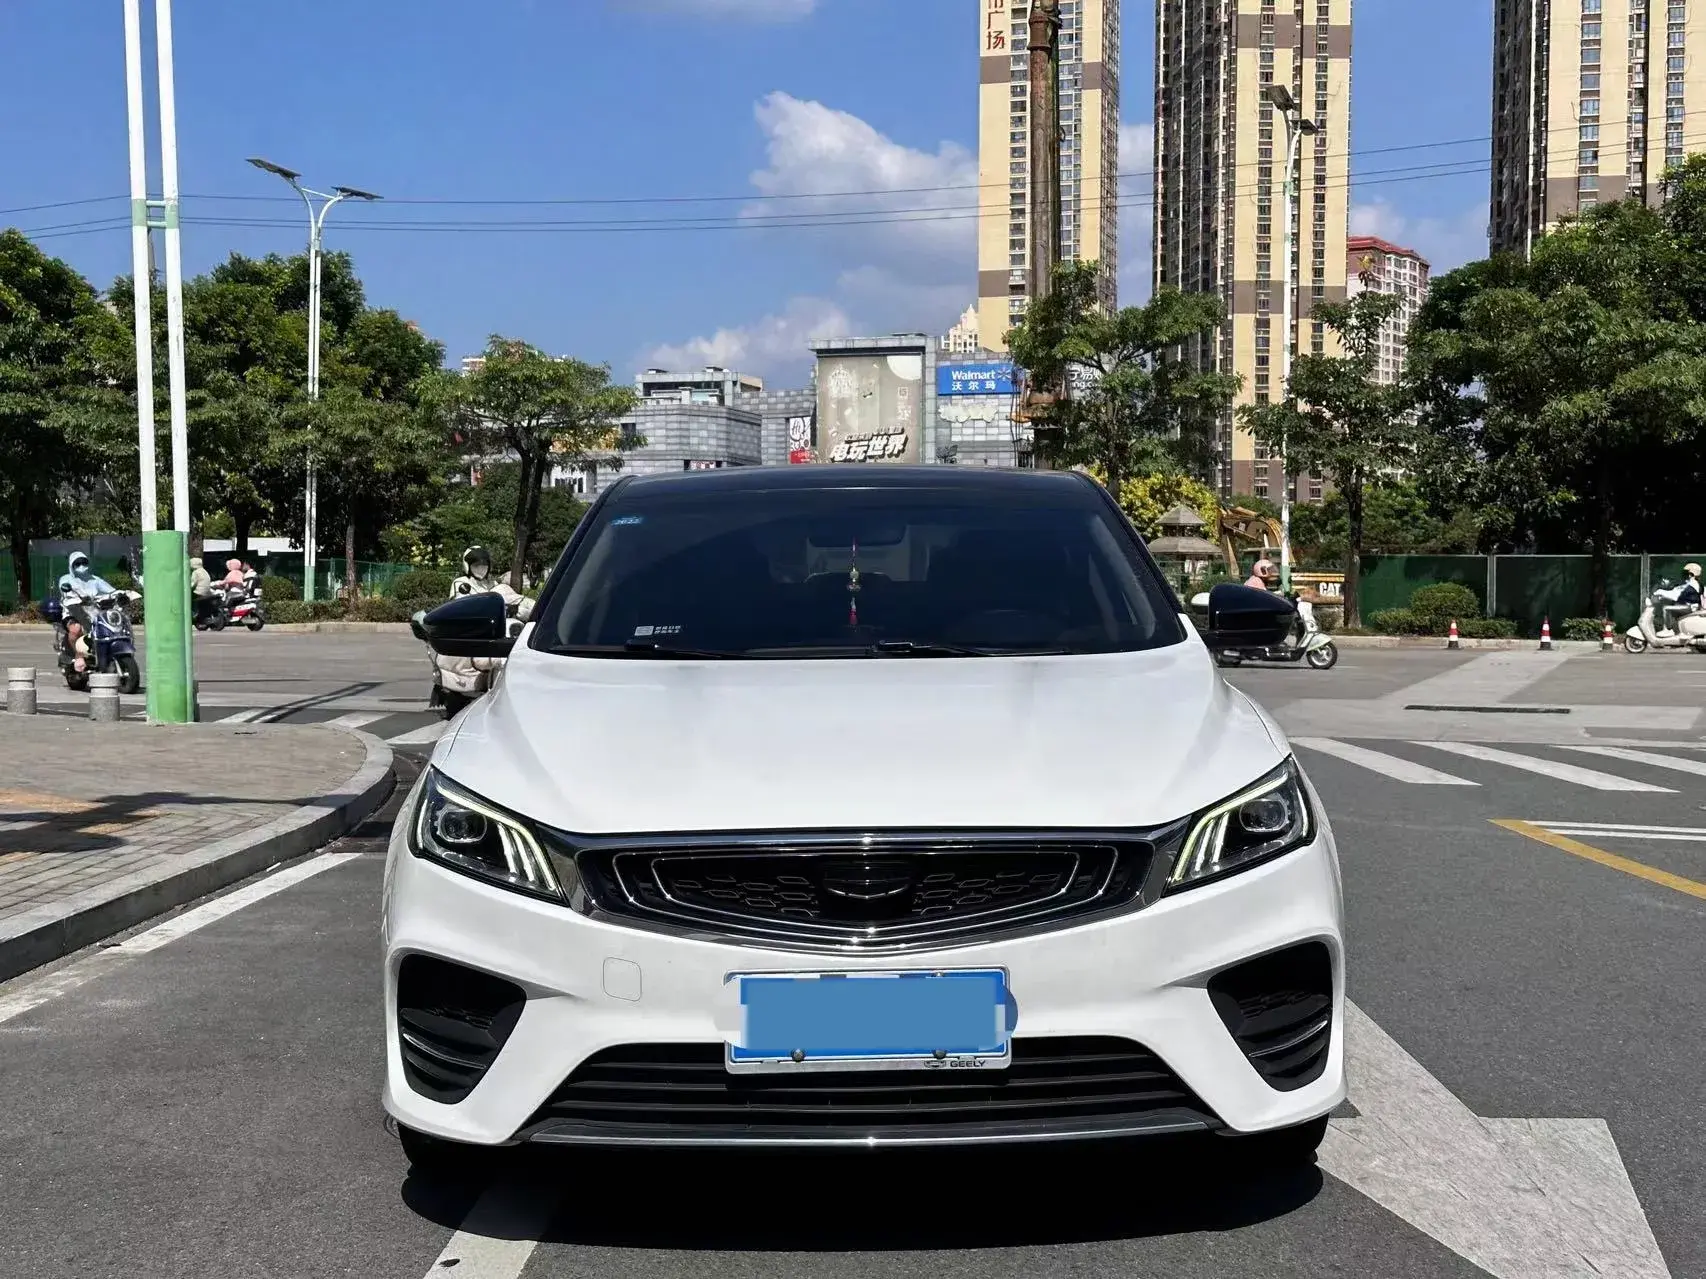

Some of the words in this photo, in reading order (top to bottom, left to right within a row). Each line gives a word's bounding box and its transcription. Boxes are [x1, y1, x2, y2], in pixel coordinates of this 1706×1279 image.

[951, 370, 996, 381] Walmart
[951, 380, 996, 391] 沃尔玛
[830, 434, 908, 462] 电玩世界
[1319, 582, 1341, 596] CAT
[950, 1060, 986, 1068] GEELY
